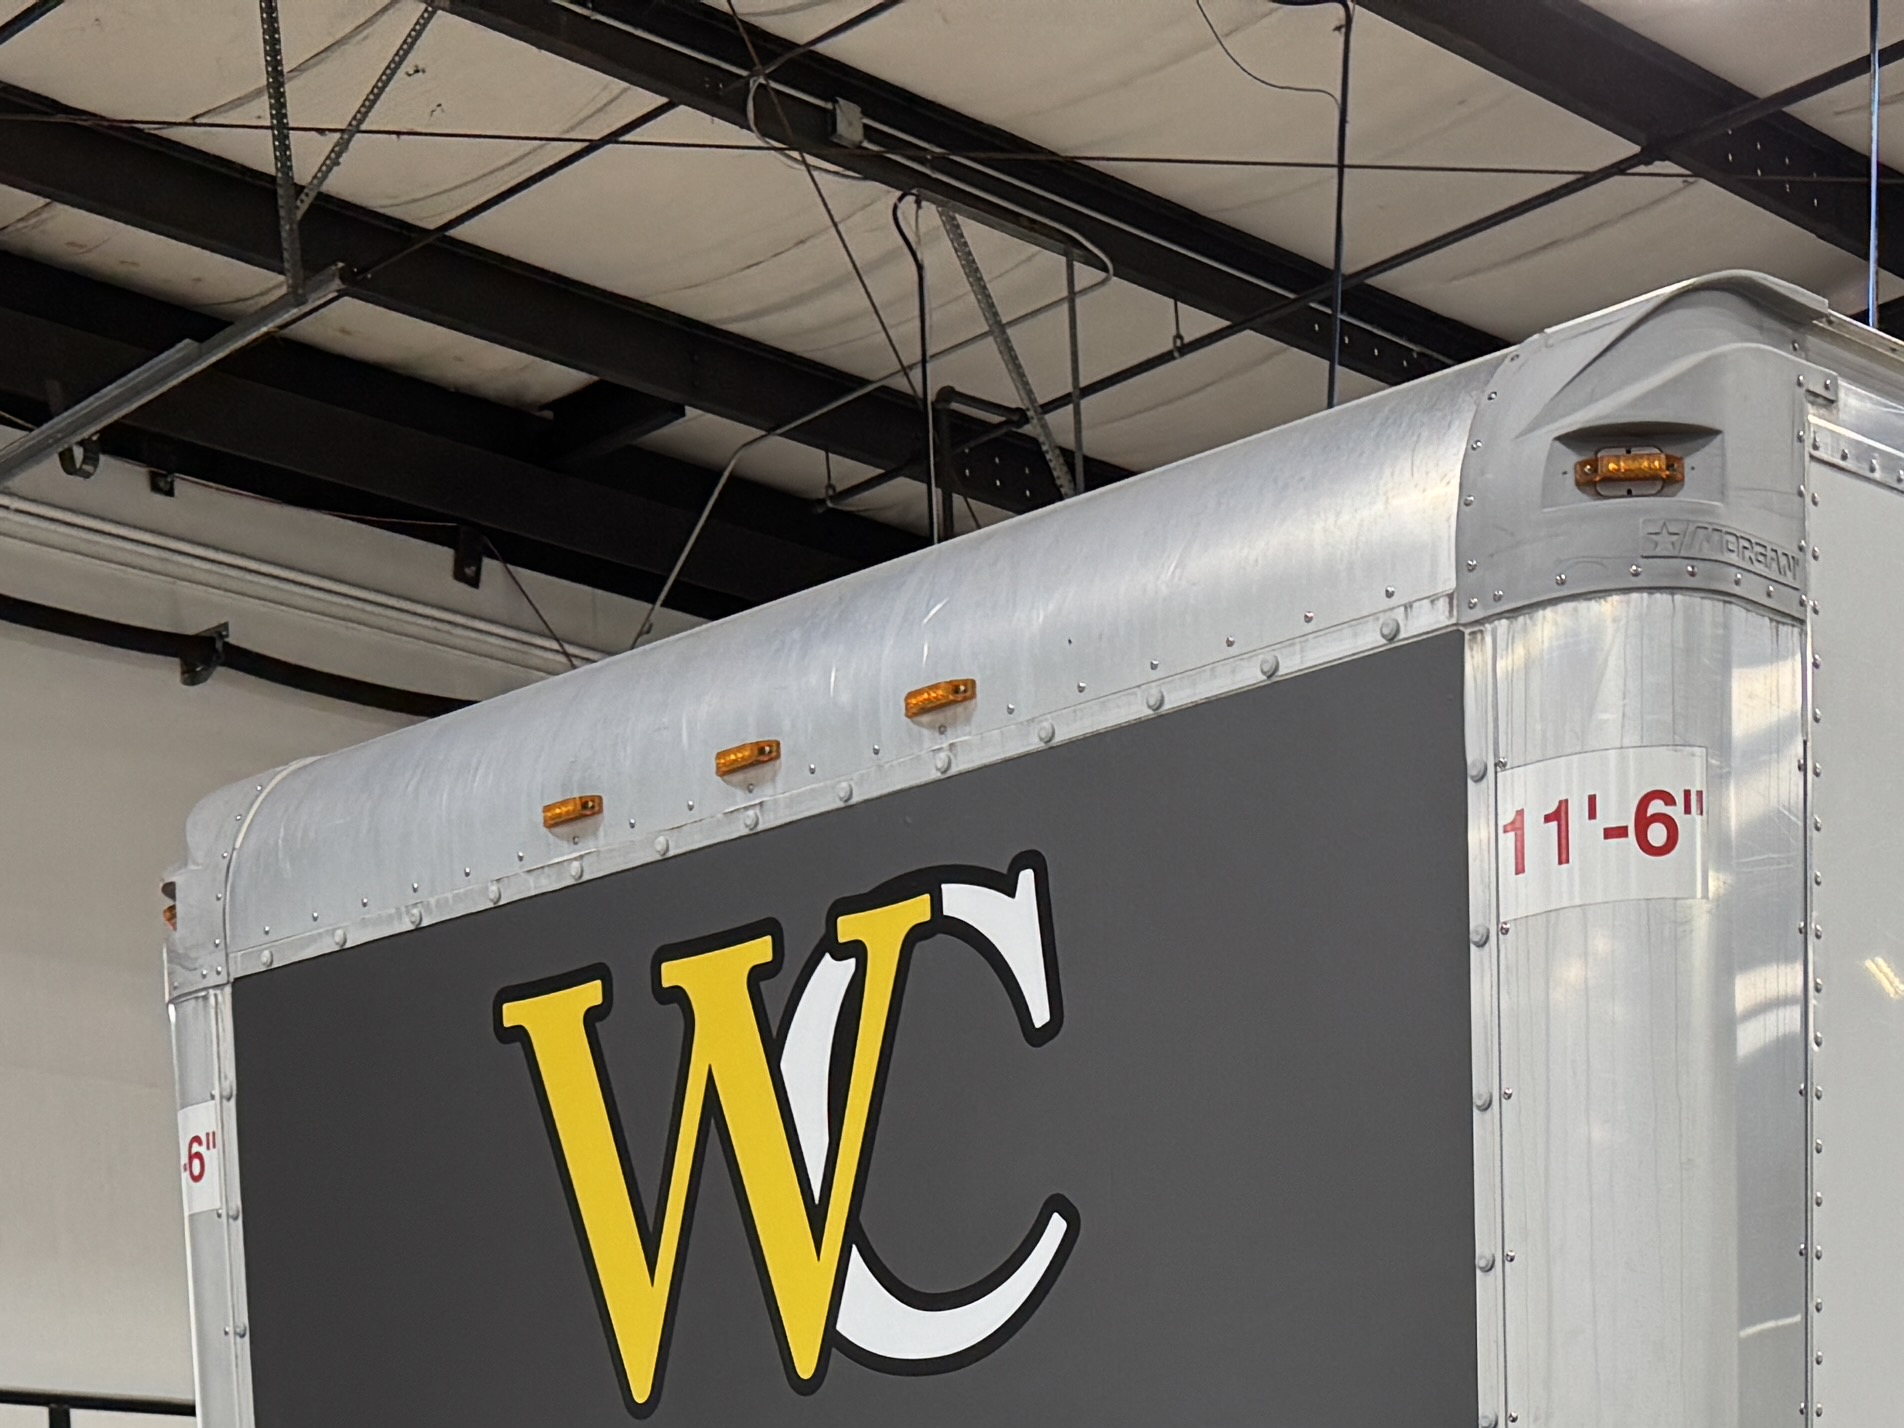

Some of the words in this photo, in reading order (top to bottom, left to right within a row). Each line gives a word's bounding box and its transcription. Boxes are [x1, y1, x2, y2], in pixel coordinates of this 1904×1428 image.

[1689, 524, 1798, 582] MORGAN
[1502, 788, 1704, 876] 11'-6"
[494, 849, 1080, 1416] WC
